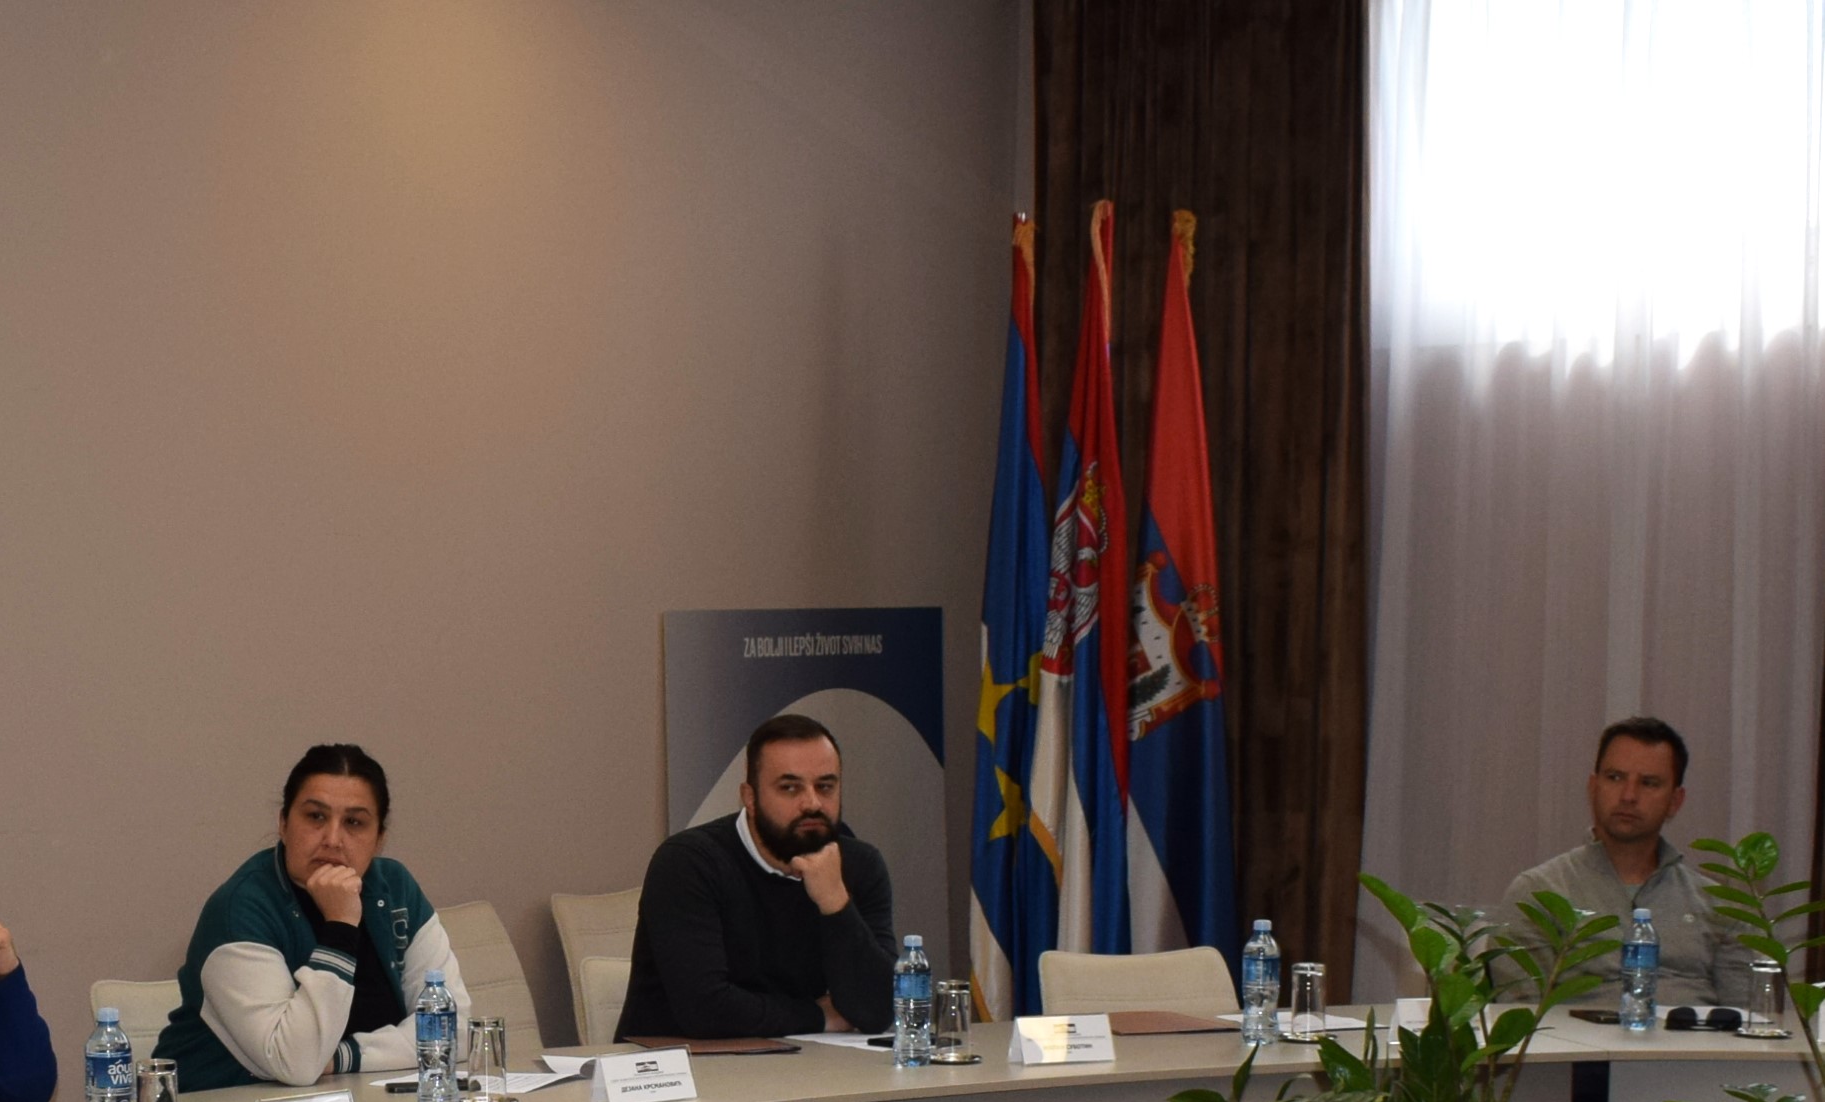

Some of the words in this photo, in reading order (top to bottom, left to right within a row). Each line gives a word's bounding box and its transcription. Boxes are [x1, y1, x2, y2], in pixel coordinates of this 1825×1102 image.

[744, 637, 756, 658] ZA
[757, 636, 783, 658] BOLJI
[842, 635, 863, 655] SVIH
[864, 634, 883, 654] NAS
